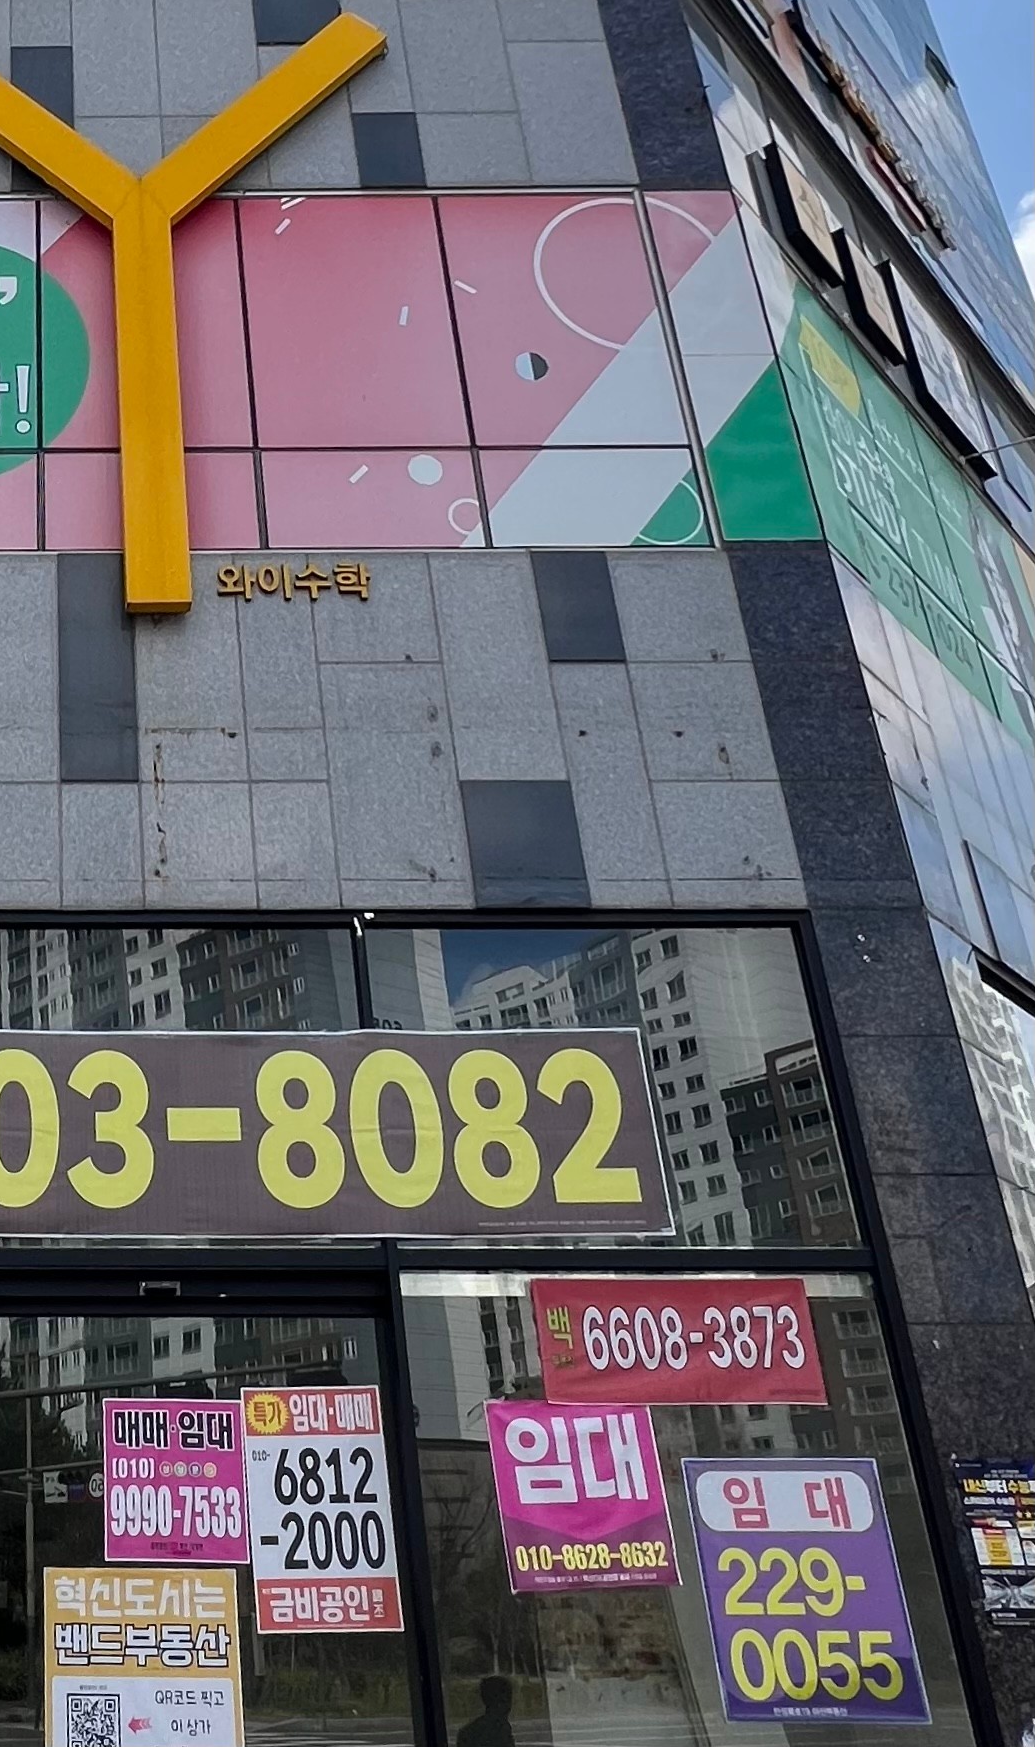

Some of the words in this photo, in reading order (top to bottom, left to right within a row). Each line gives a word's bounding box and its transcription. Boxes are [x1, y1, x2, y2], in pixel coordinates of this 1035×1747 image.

[217, 561, 371, 601] 와이수학
[582, 1304, 807, 1371] 6608-3873
[253, 1400, 282, 1427] 특가
[274, 1446, 378, 1506] 6812
[504, 1412, 650, 1506] 임대
[110, 1484, 242, 1539] 9990-7533
[515, 1540, 668, 1572] 010-8628-8632
[53, 1576, 227, 1618] 혁신도시는
[269, 1585, 370, 1623] 금비공인
[54, 1623, 232, 1667] 밴드부동산
[729, 1627, 905, 1703] 0055
[154, 1690, 197, 1706] QR코드
[171, 1719, 183, 1733] 이
[187, 1719, 212, 1737] 상가
